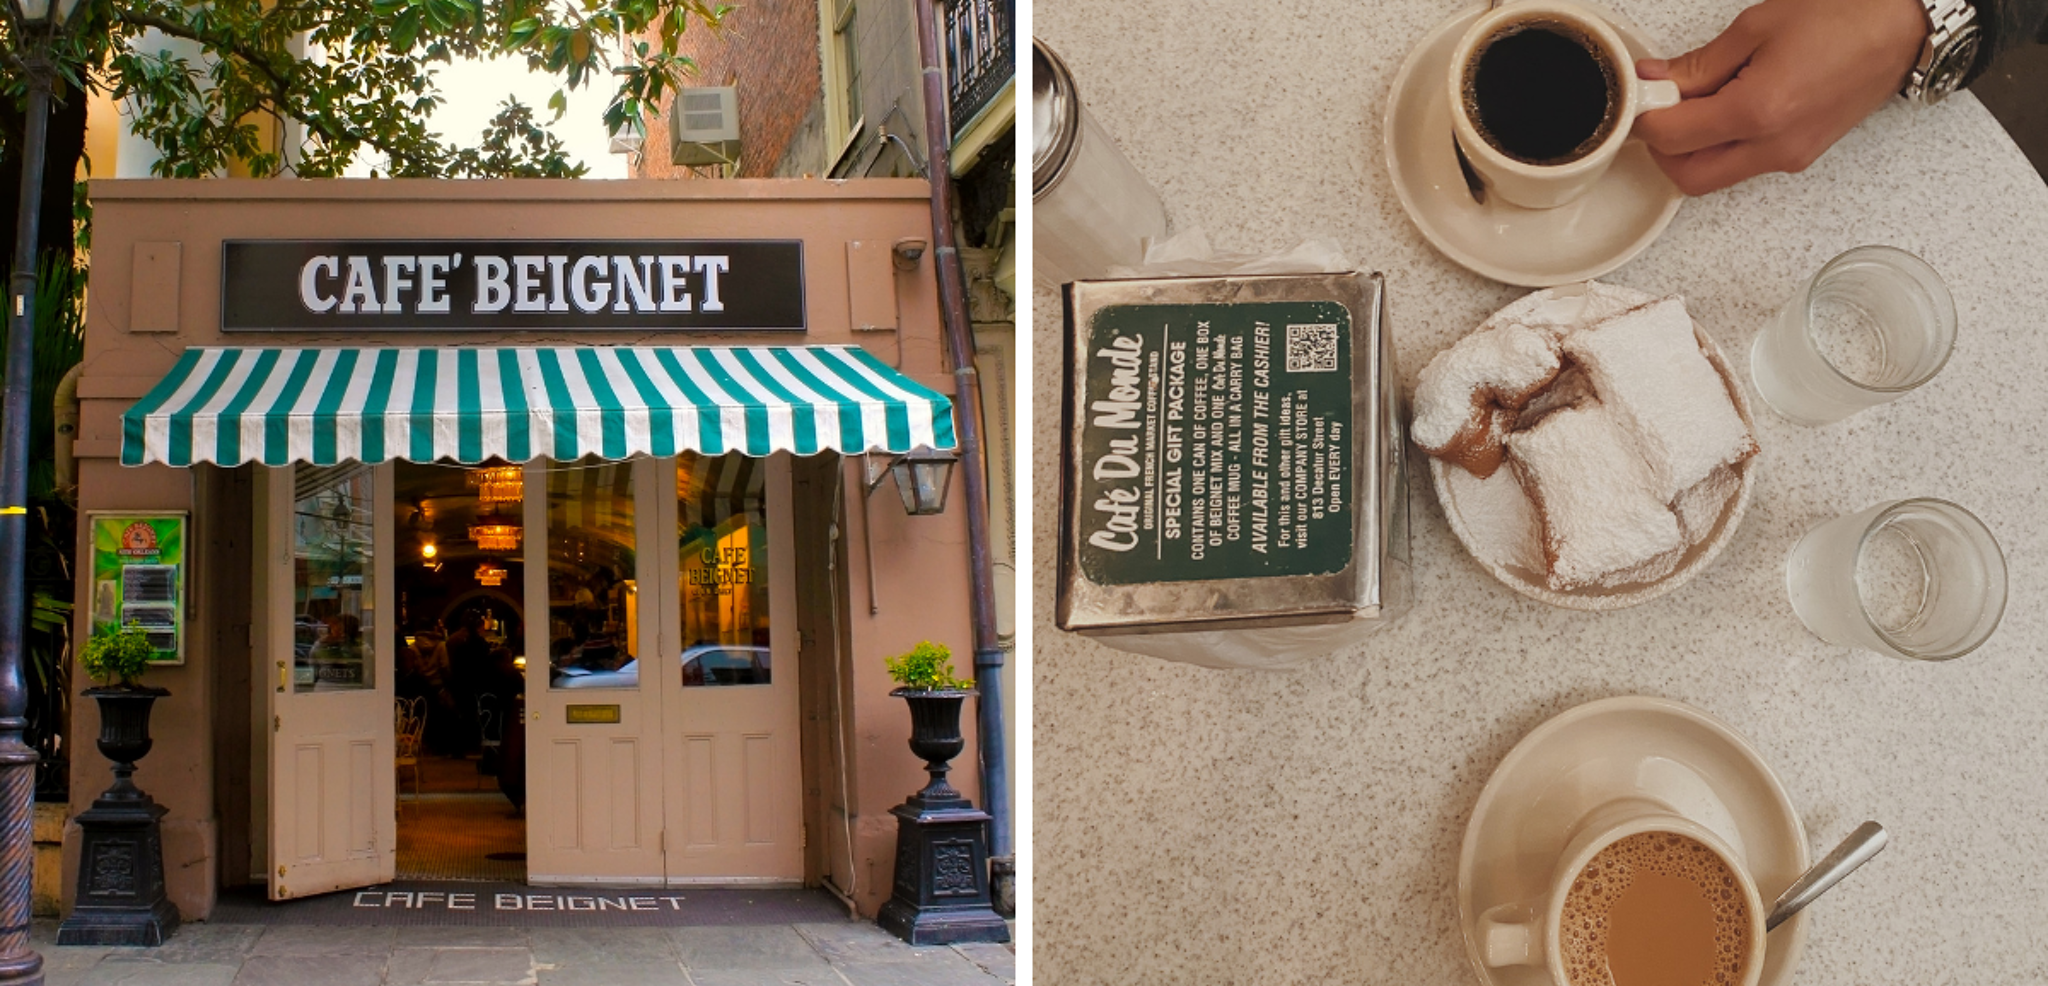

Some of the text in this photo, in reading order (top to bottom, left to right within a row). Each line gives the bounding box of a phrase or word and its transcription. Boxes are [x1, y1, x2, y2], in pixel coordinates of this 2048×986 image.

[471, 255, 730, 314] BEIGNET
[1230, 336, 1243, 359] BAG
[1148, 351, 1159, 378] STAND
[1230, 362, 1243, 401] CARRY
[1211, 395, 1224, 418] ONE
[1229, 404, 1242, 412] A
[1145, 415, 1156, 450] MARKET
[1211, 422, 1224, 446] AND
[1228, 415, 1241, 427] IN
[1088, 334, 1143, 551] Café Du Monde
[1165, 342, 1186, 539] SPECIAL GIFT PACKAGE
[1191, 321, 1210, 560] CONTAINS ONE CAN OF COFFEE, ONE BOX
[1228, 430, 1241, 452] ALL
[1252, 321, 1270, 553] AVAILABLE FROM THE CASHIER!
[1278, 428, 1294, 446] gift
[1144, 452, 1155, 486] FRENCH
[1210, 450, 1223, 473] MIX
[1278, 449, 1291, 478] other
[1295, 390, 1308, 548] visit our COMPANY STORE at
[1312, 416, 1325, 519] 813 Decatur Street
[1328, 422, 1343, 512] Open EVERY day
[1228, 464, 1241, 492] MUG
[1278, 481, 1291, 502] and
[1144, 488, 1154, 530] ORIGINAL
[1210, 476, 1223, 526] BEIGNET
[1227, 495, 1240, 540] COFFEE
[1278, 505, 1291, 526] this
[1209, 530, 1222, 546] OF
[1278, 529, 1291, 547] For
[689, 568, 755, 585] BEIGNET
[353, 891, 686, 910] CAFE BEIGNET
